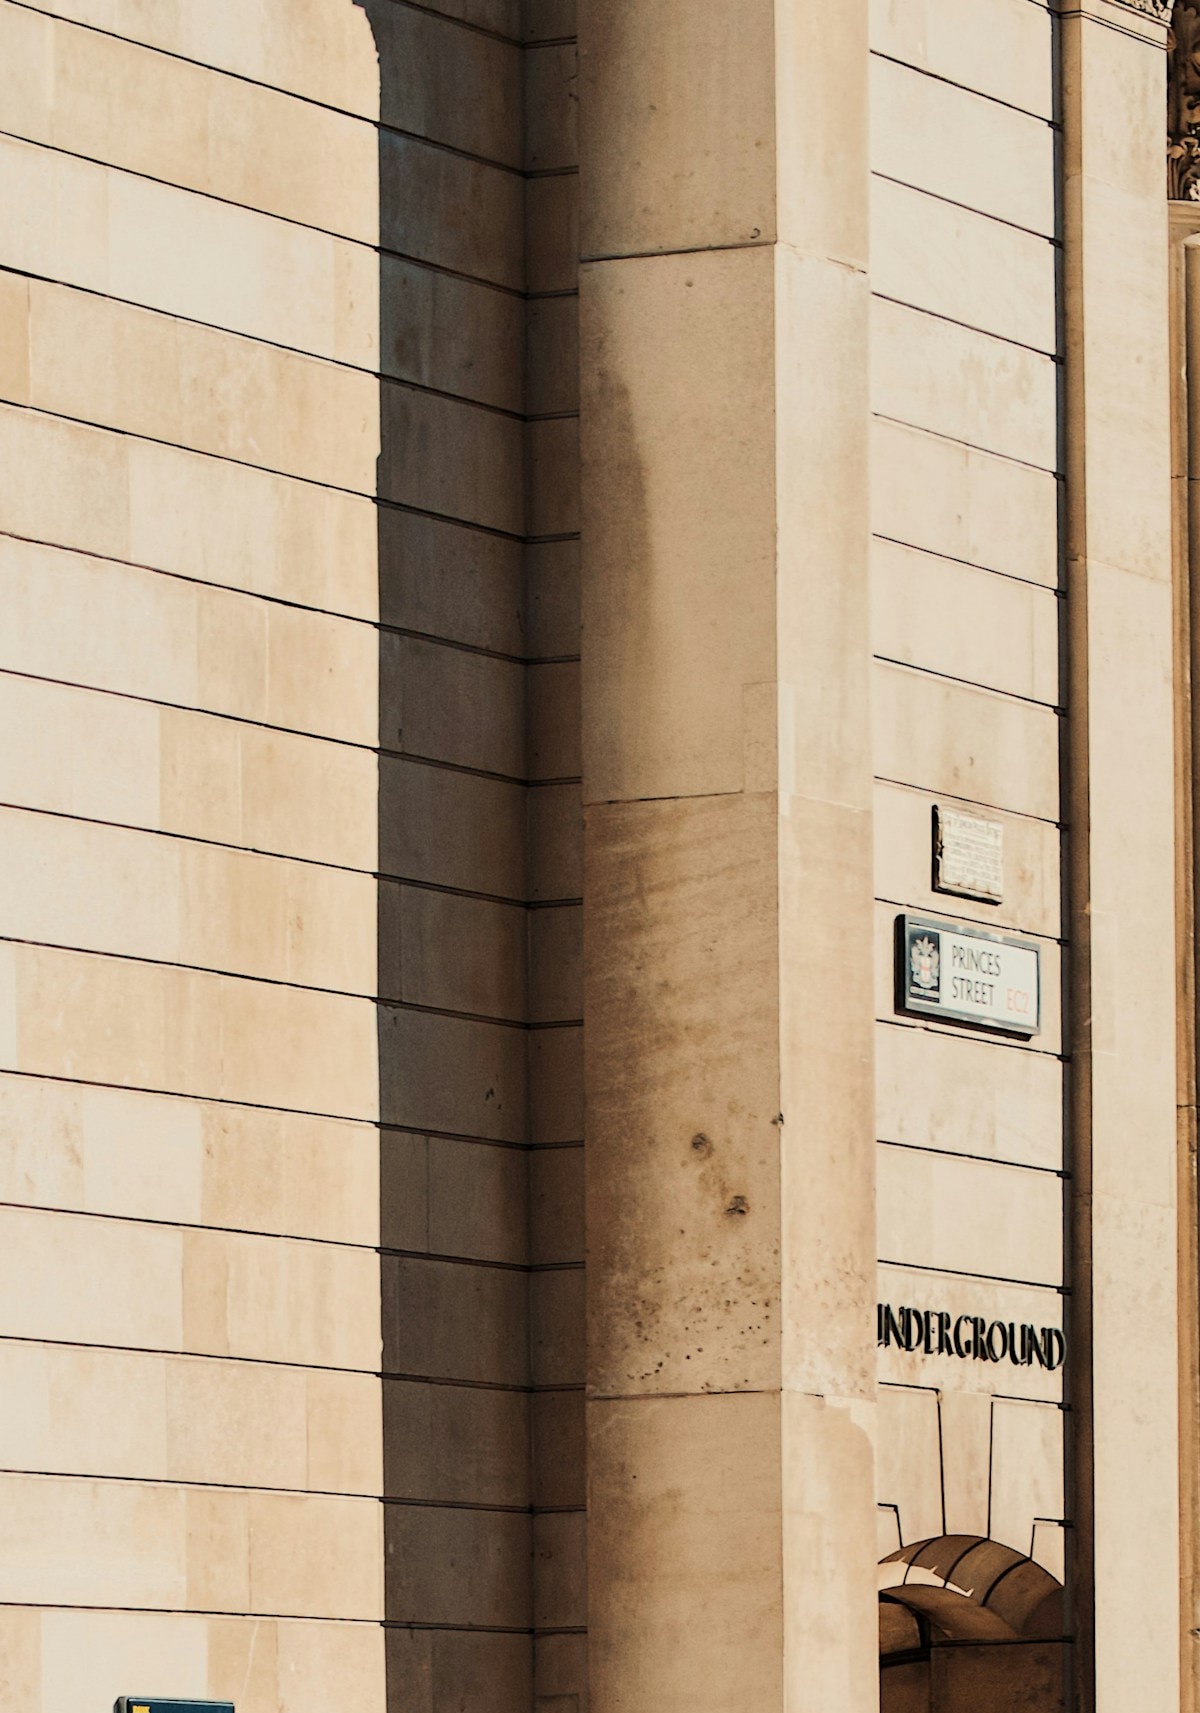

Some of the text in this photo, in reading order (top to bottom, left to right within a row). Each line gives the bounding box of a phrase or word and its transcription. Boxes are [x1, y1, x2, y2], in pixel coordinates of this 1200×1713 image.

[952, 945, 1001, 976] PRINCES
[952, 976, 1029, 1014] STREET EC2
